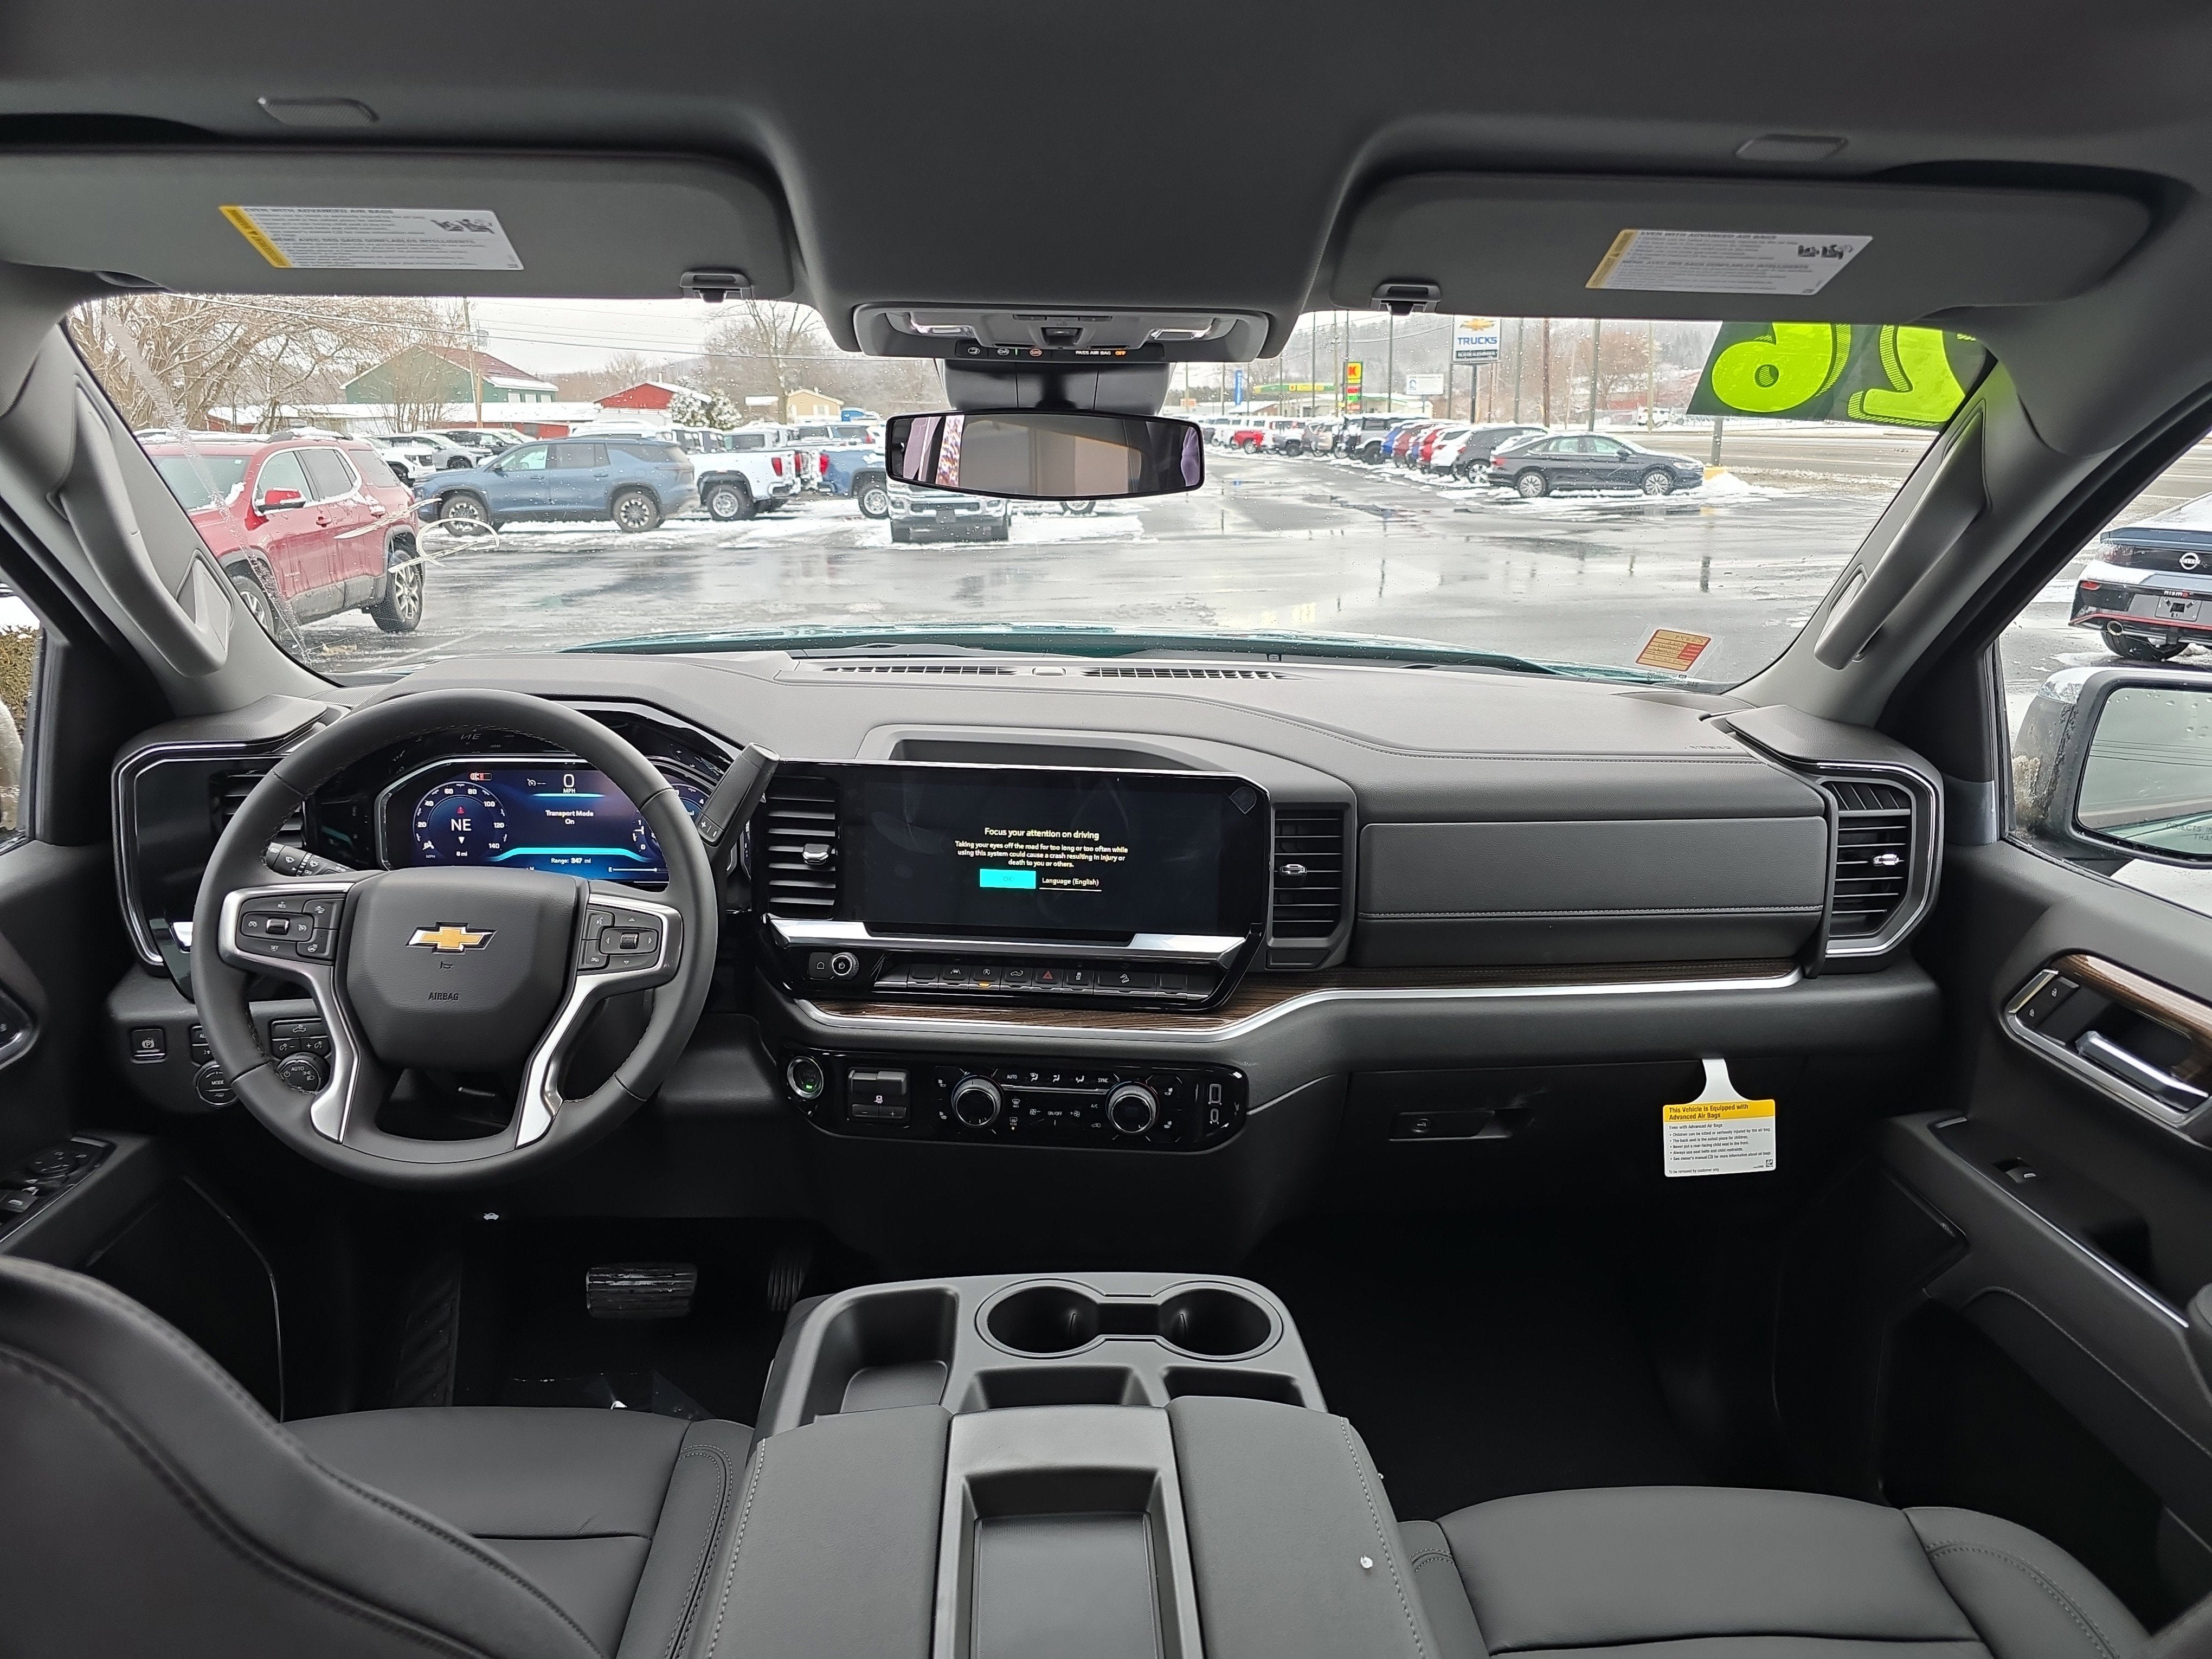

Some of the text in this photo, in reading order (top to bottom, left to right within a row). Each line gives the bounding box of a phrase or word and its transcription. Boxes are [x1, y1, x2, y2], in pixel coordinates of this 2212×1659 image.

[1458, 337, 1497, 345] TRUCKS
[563, 774, 575, 788] 0
[451, 819, 472, 831] NE
[2166, 823, 2201, 832] OBJECTS
[985, 827, 1007, 835] Focus
[1026, 829, 1060, 838] attention
[1073, 830, 1099, 841] driving
[955, 840, 974, 849] Taking
[1062, 844, 1075, 852] long
[1066, 853, 1093, 861] resulting
[1101, 854, 1118, 862] injury
[1042, 877, 1099, 886] Language (English)
[428, 992, 459, 1000] AIRBAG
